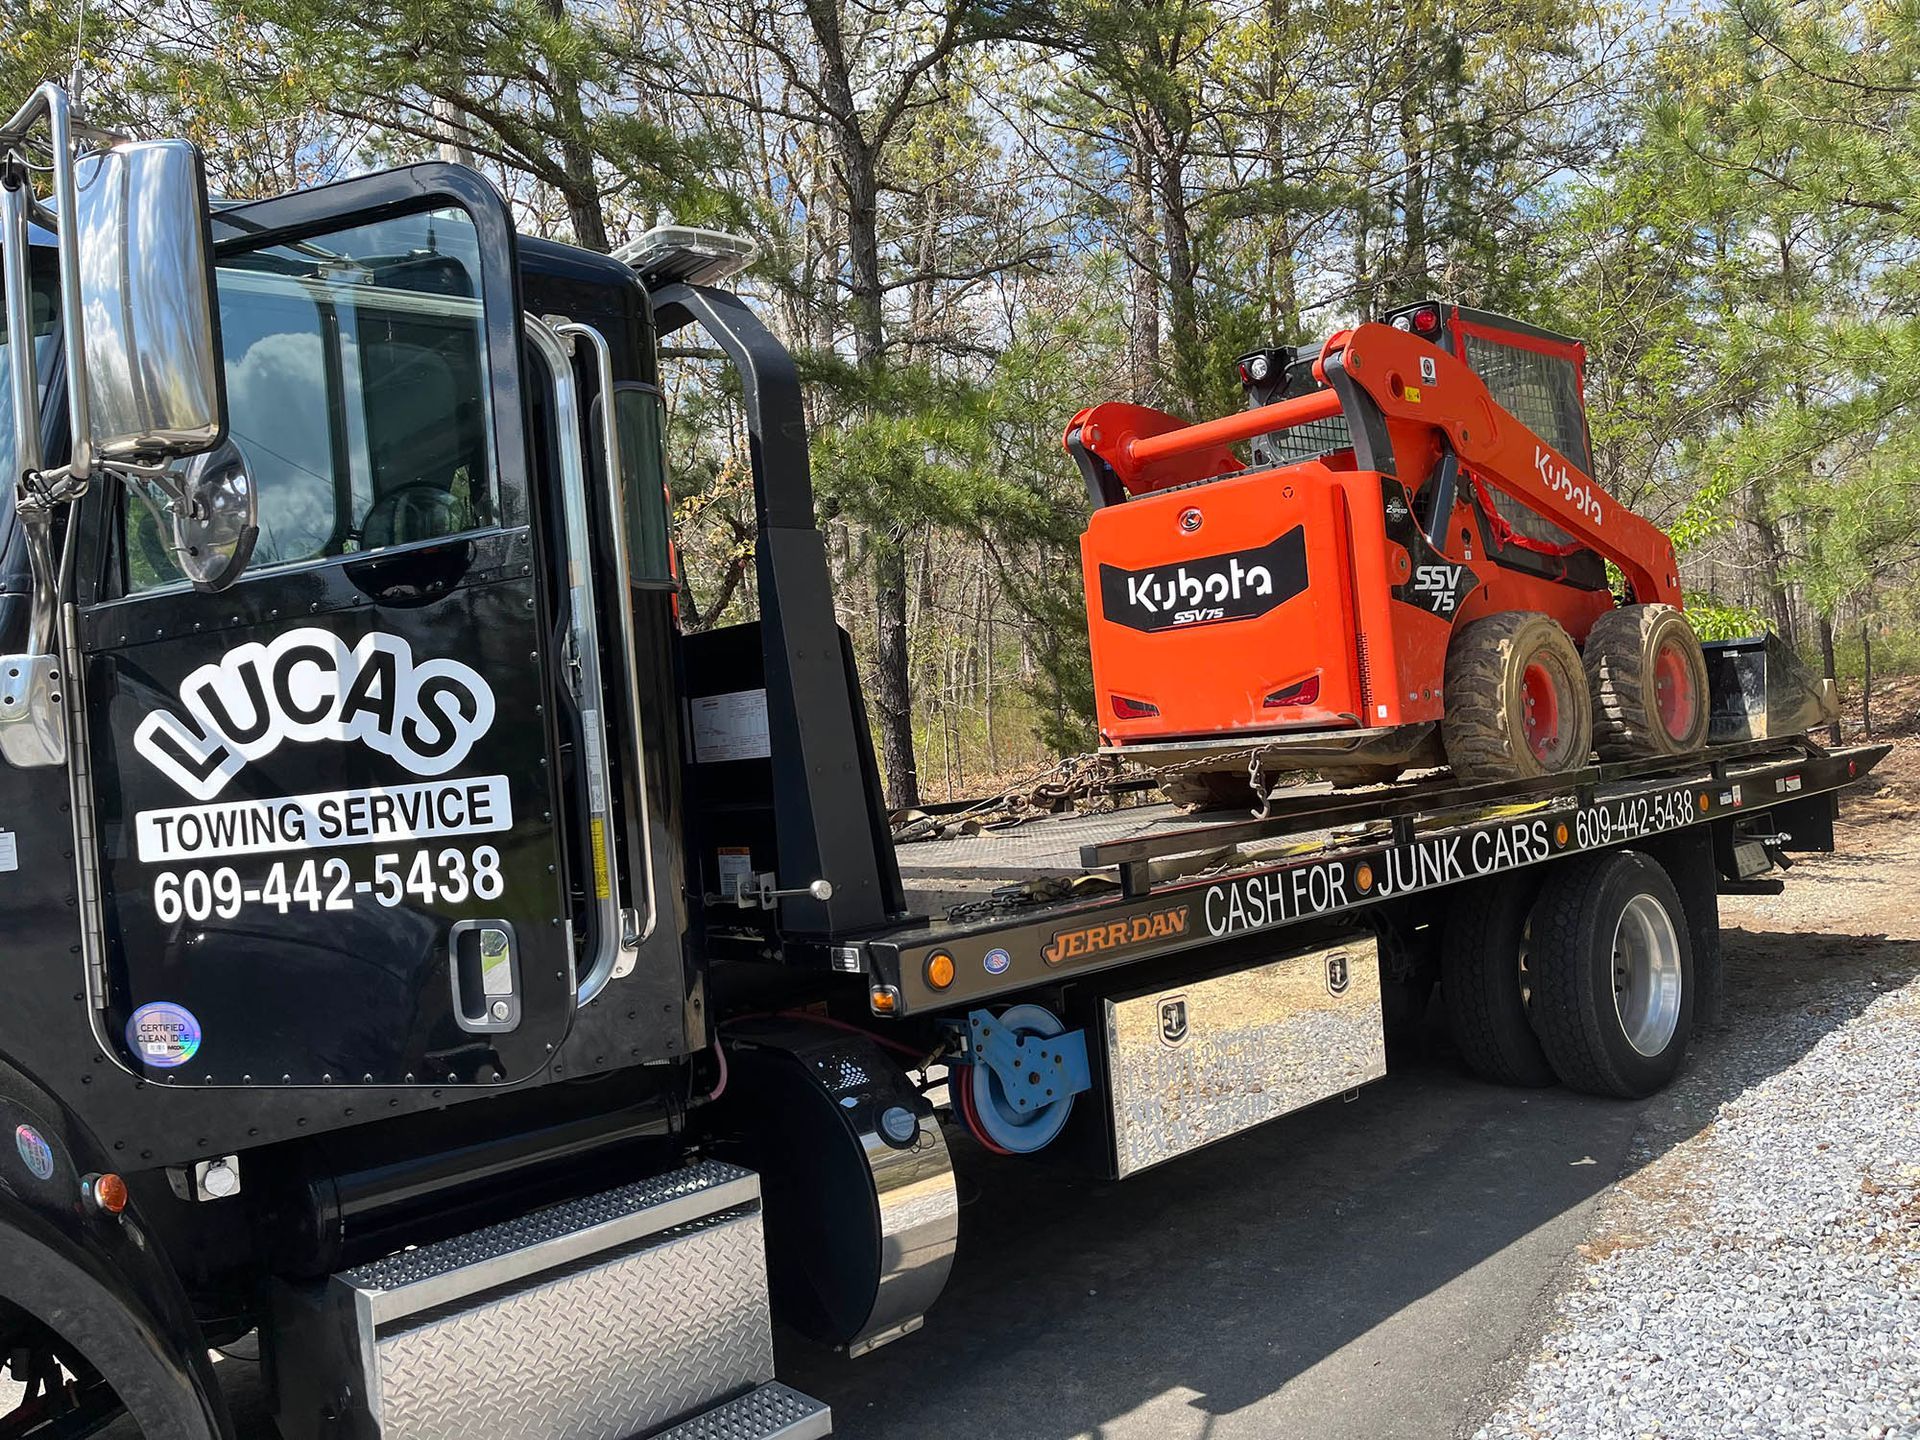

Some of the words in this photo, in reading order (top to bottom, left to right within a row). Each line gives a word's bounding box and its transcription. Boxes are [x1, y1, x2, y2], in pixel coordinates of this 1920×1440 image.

[1533, 445, 1603, 526] Kubota
[1127, 557, 1273, 613] Kubota
[1414, 565, 1462, 590] SSV
[1431, 591, 1455, 611] 75
[149, 645, 476, 782] LUCAS
[153, 803, 306, 852] TOWING
[319, 784, 494, 839] SERVICE
[1575, 789, 1695, 849] 609-442-5438
[154, 845, 504, 924] 609-442-5438
[1205, 875, 1286, 937] CASH
[1292, 862, 1349, 917] FOR
[1377, 836, 1465, 897] JUNK
[1472, 820, 1550, 874] CARS
[137, 1034, 167, 1043] CLEAN
[170, 1034, 190, 1042] IDLE
[140, 1023, 185, 1032] CERTIFIED
